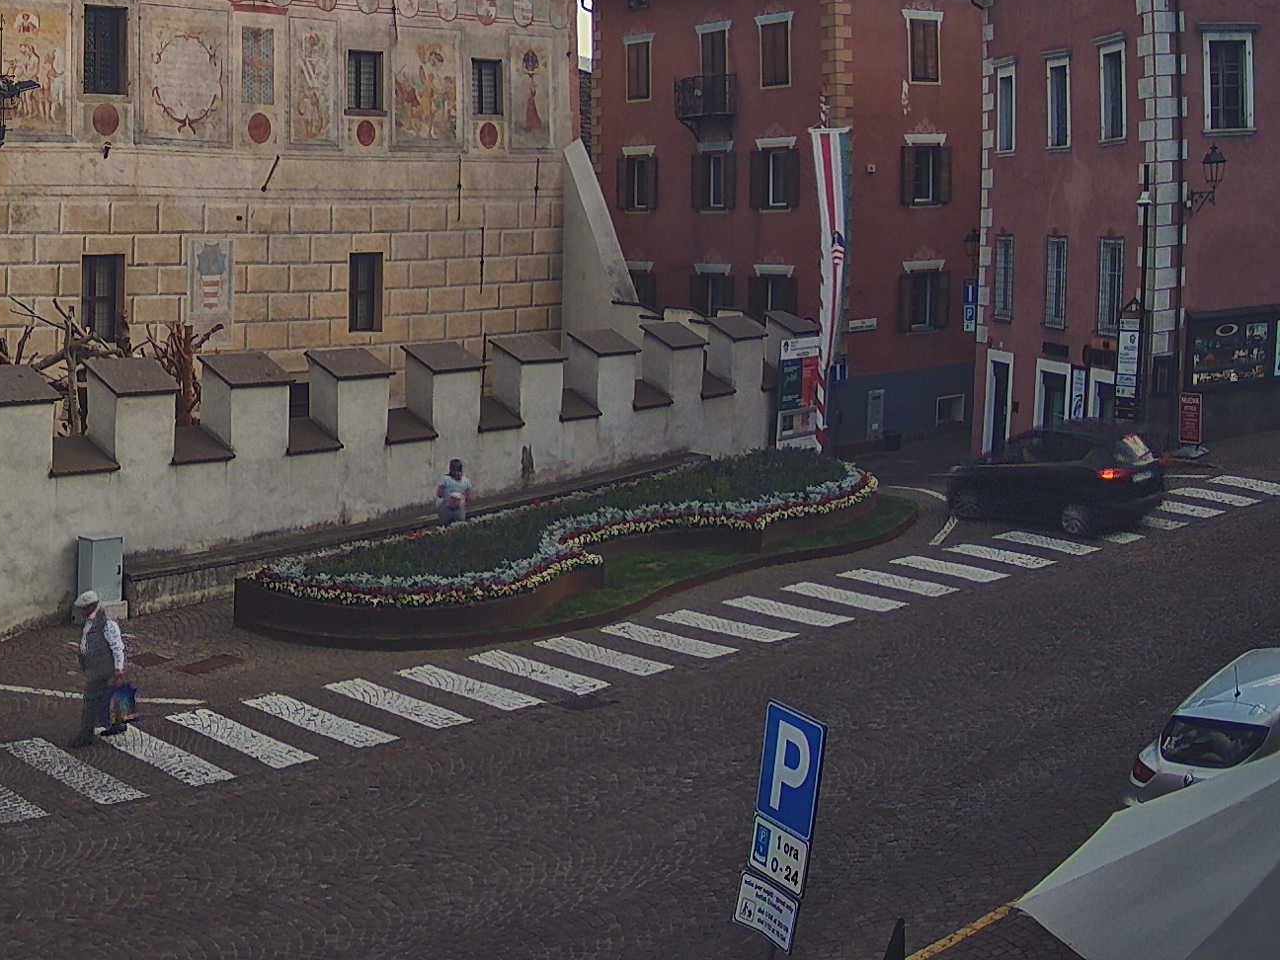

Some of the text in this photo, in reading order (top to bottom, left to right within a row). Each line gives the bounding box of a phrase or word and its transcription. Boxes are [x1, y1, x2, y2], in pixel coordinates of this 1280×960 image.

[769, 719, 810, 811] P
[777, 835, 799, 861] 1 ora
